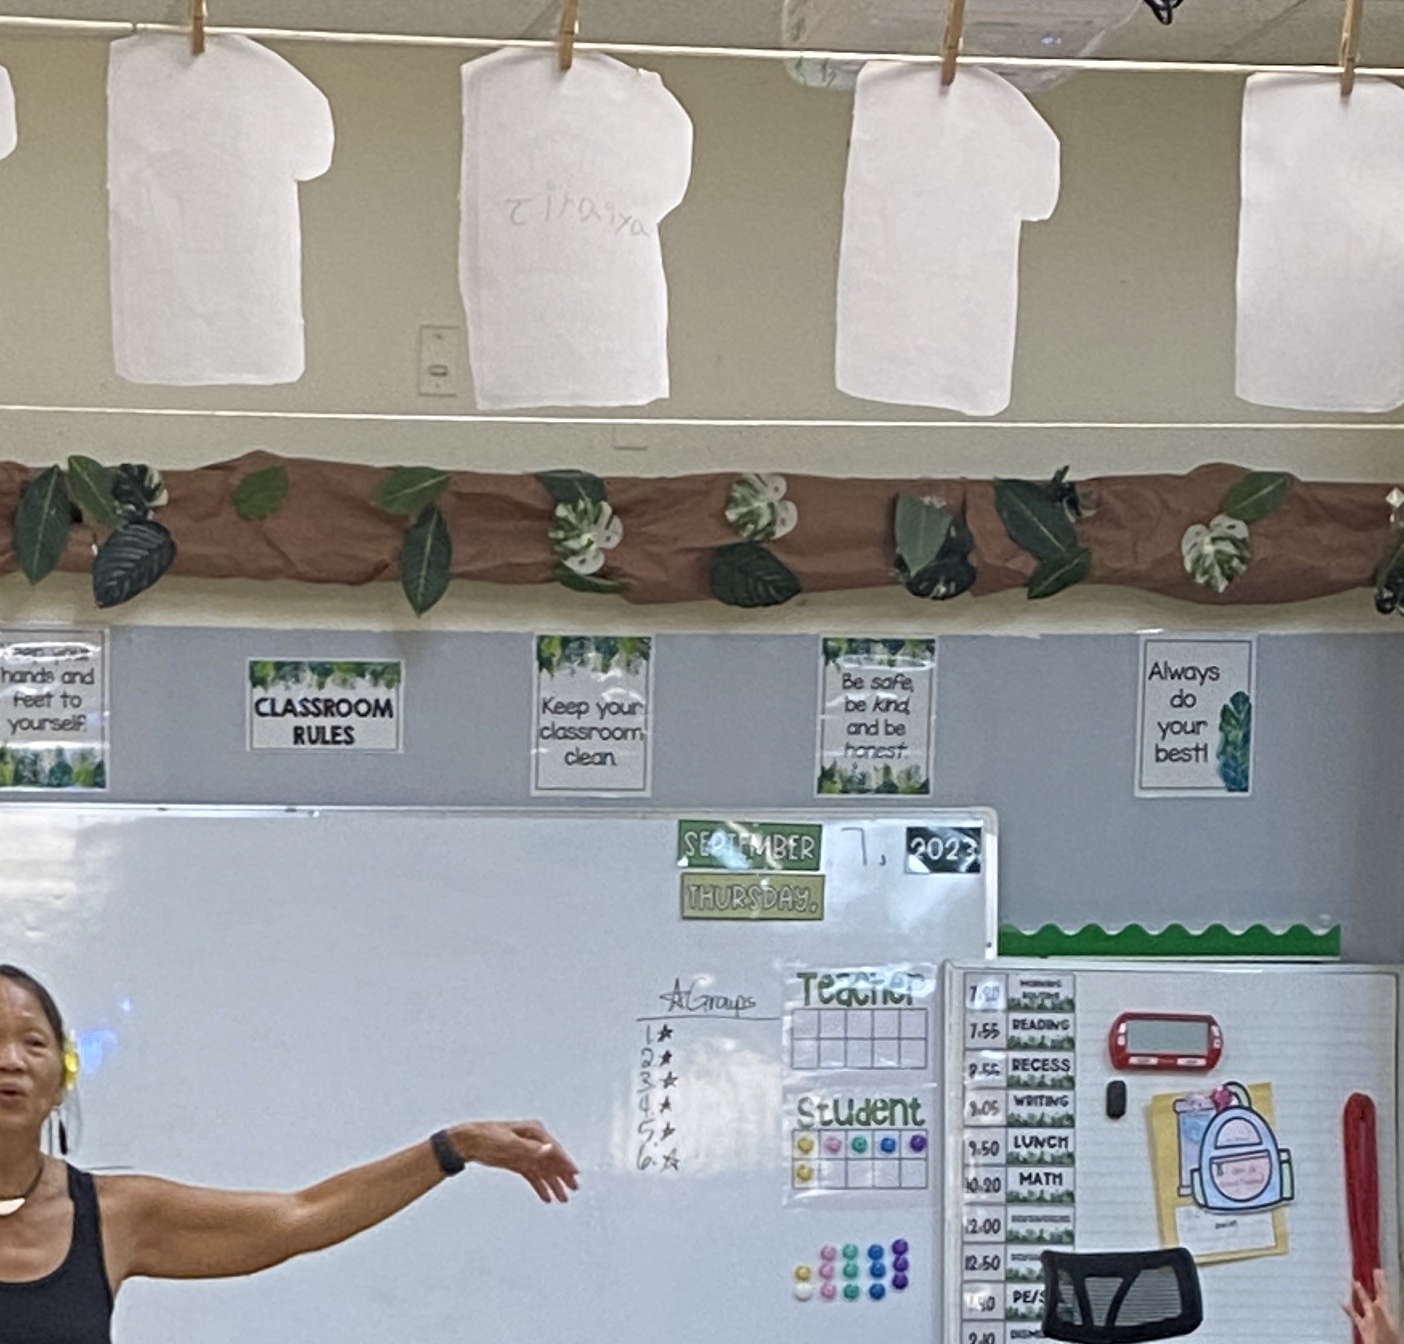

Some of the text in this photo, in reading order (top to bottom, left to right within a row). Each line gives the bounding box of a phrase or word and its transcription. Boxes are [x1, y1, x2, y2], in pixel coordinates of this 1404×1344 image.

[1, 667, 95, 685] hands and
[842, 673, 864, 689] Be
[1148, 661, 1220, 686] Always
[60, 691, 82, 708] to
[254, 697, 394, 718] CLASSROOM
[542, 696, 643, 719] Keep your
[845, 696, 866, 712] be
[1170, 689, 1197, 708] do
[293, 725, 355, 745] RULES
[540, 722, 645, 741] classroom
[847, 719, 906, 736] and be
[1158, 720, 1208, 741] your
[684, 830, 816, 860] SEPTEMBER
[1012, 1019, 1070, 1030] READING
[1012, 1058, 1071, 1072] RECESS
[1013, 1095, 1069, 1107] WRITING
[797, 1097, 925, 1128] Student
[1014, 1136, 1069, 1149] LUNCH
[1019, 1172, 1064, 1186] MATH
